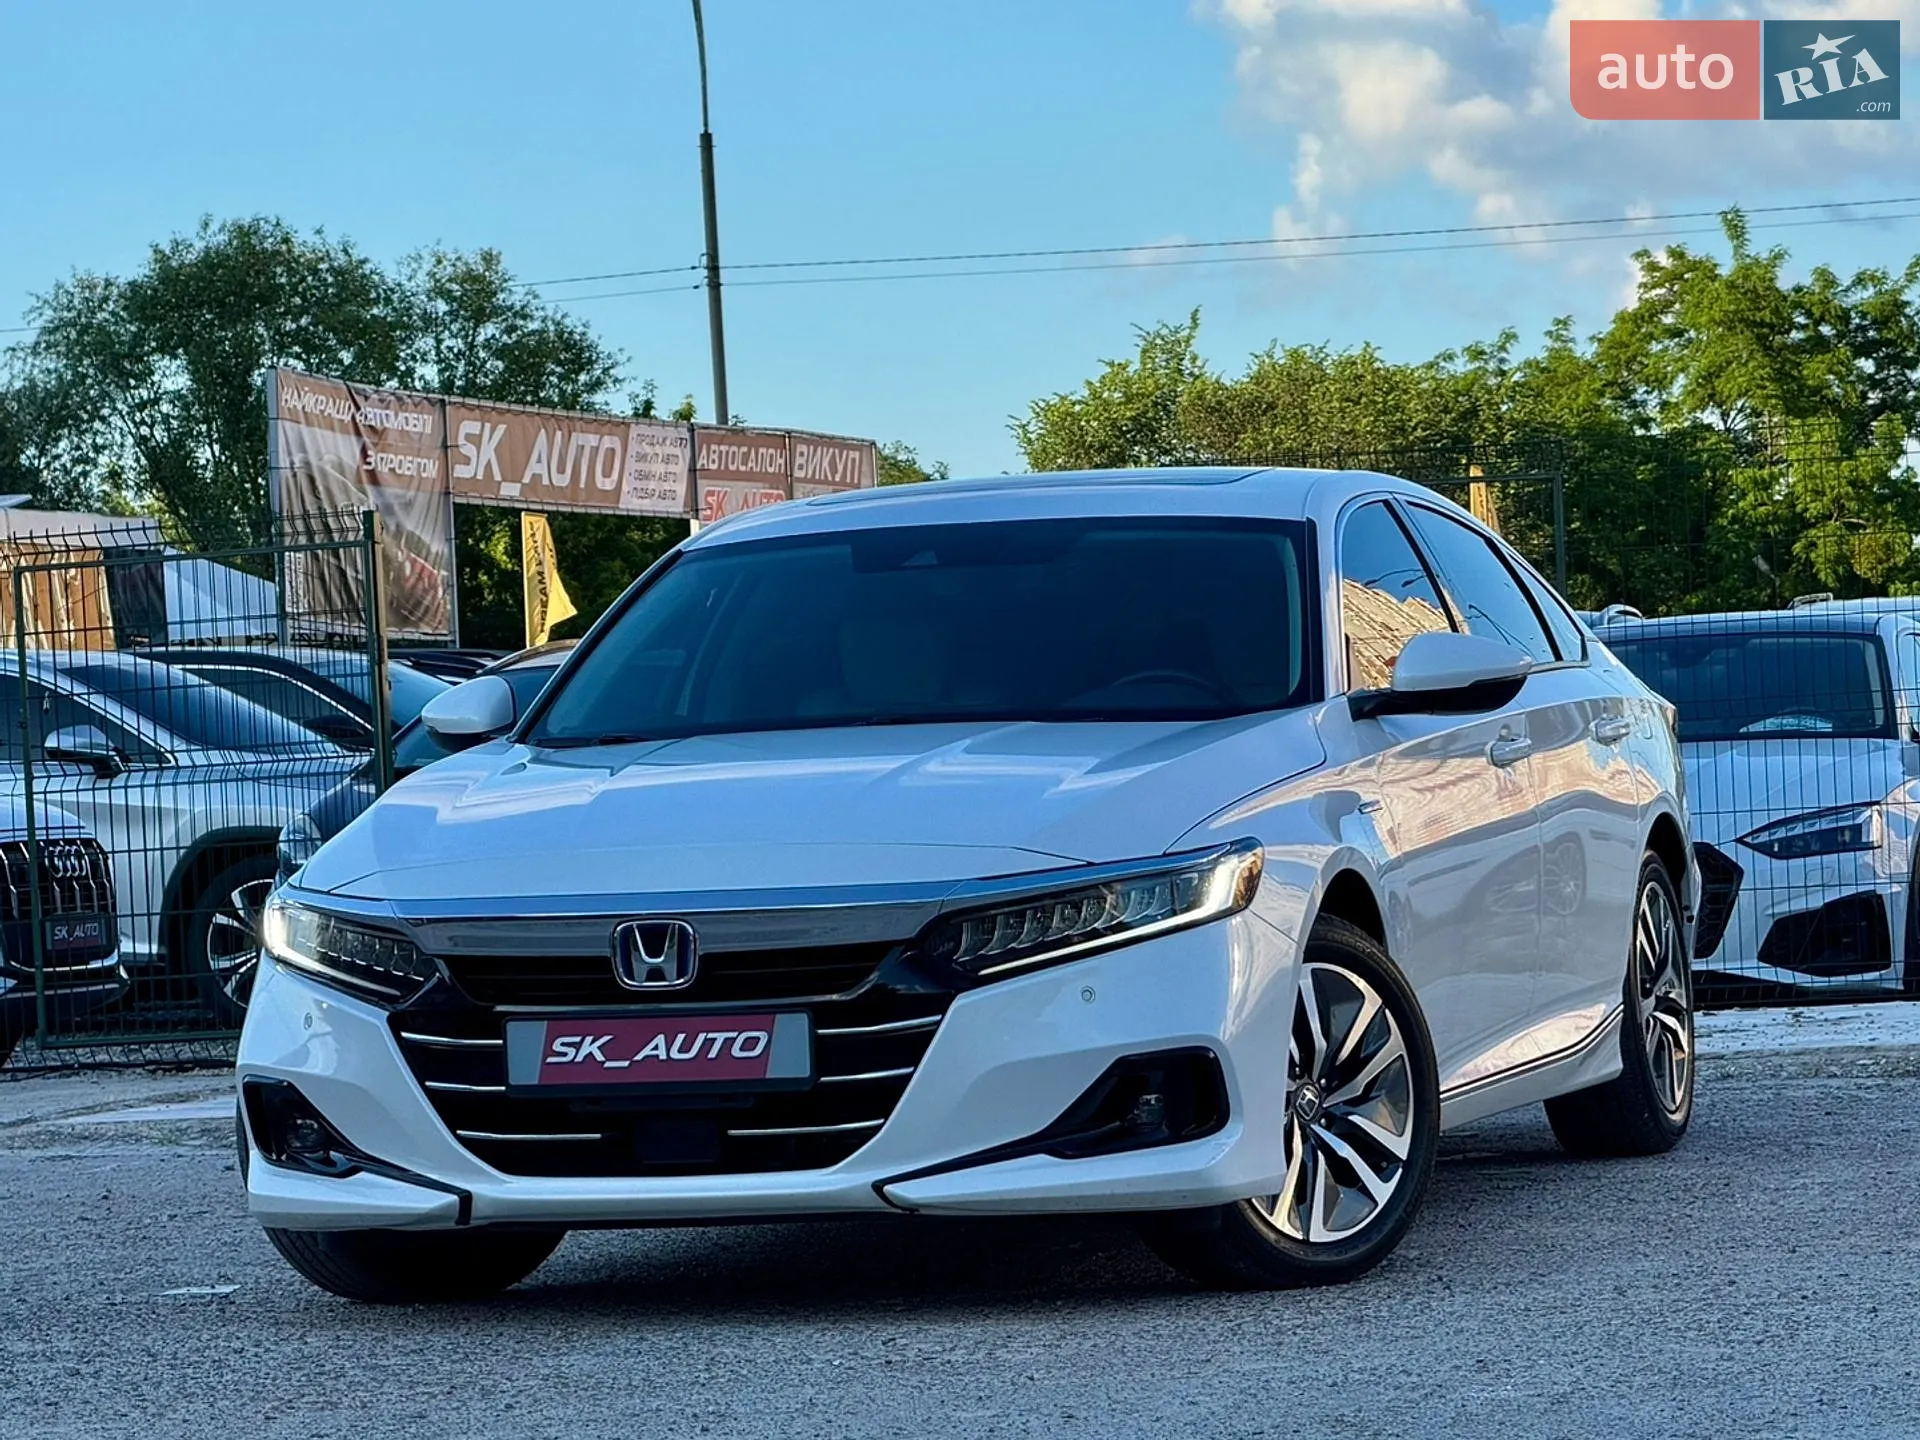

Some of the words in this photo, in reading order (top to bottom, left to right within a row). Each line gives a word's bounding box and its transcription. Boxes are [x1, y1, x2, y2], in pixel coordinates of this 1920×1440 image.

[376, 452, 438, 479] ПРОБІГОМ
[453, 420, 622, 497] SK_AUTO
[697, 443, 785, 475] АВТОСАЛОН
[794, 444, 860, 484] ВИКУП
[545, 1031, 770, 1068] SK_AUTO
